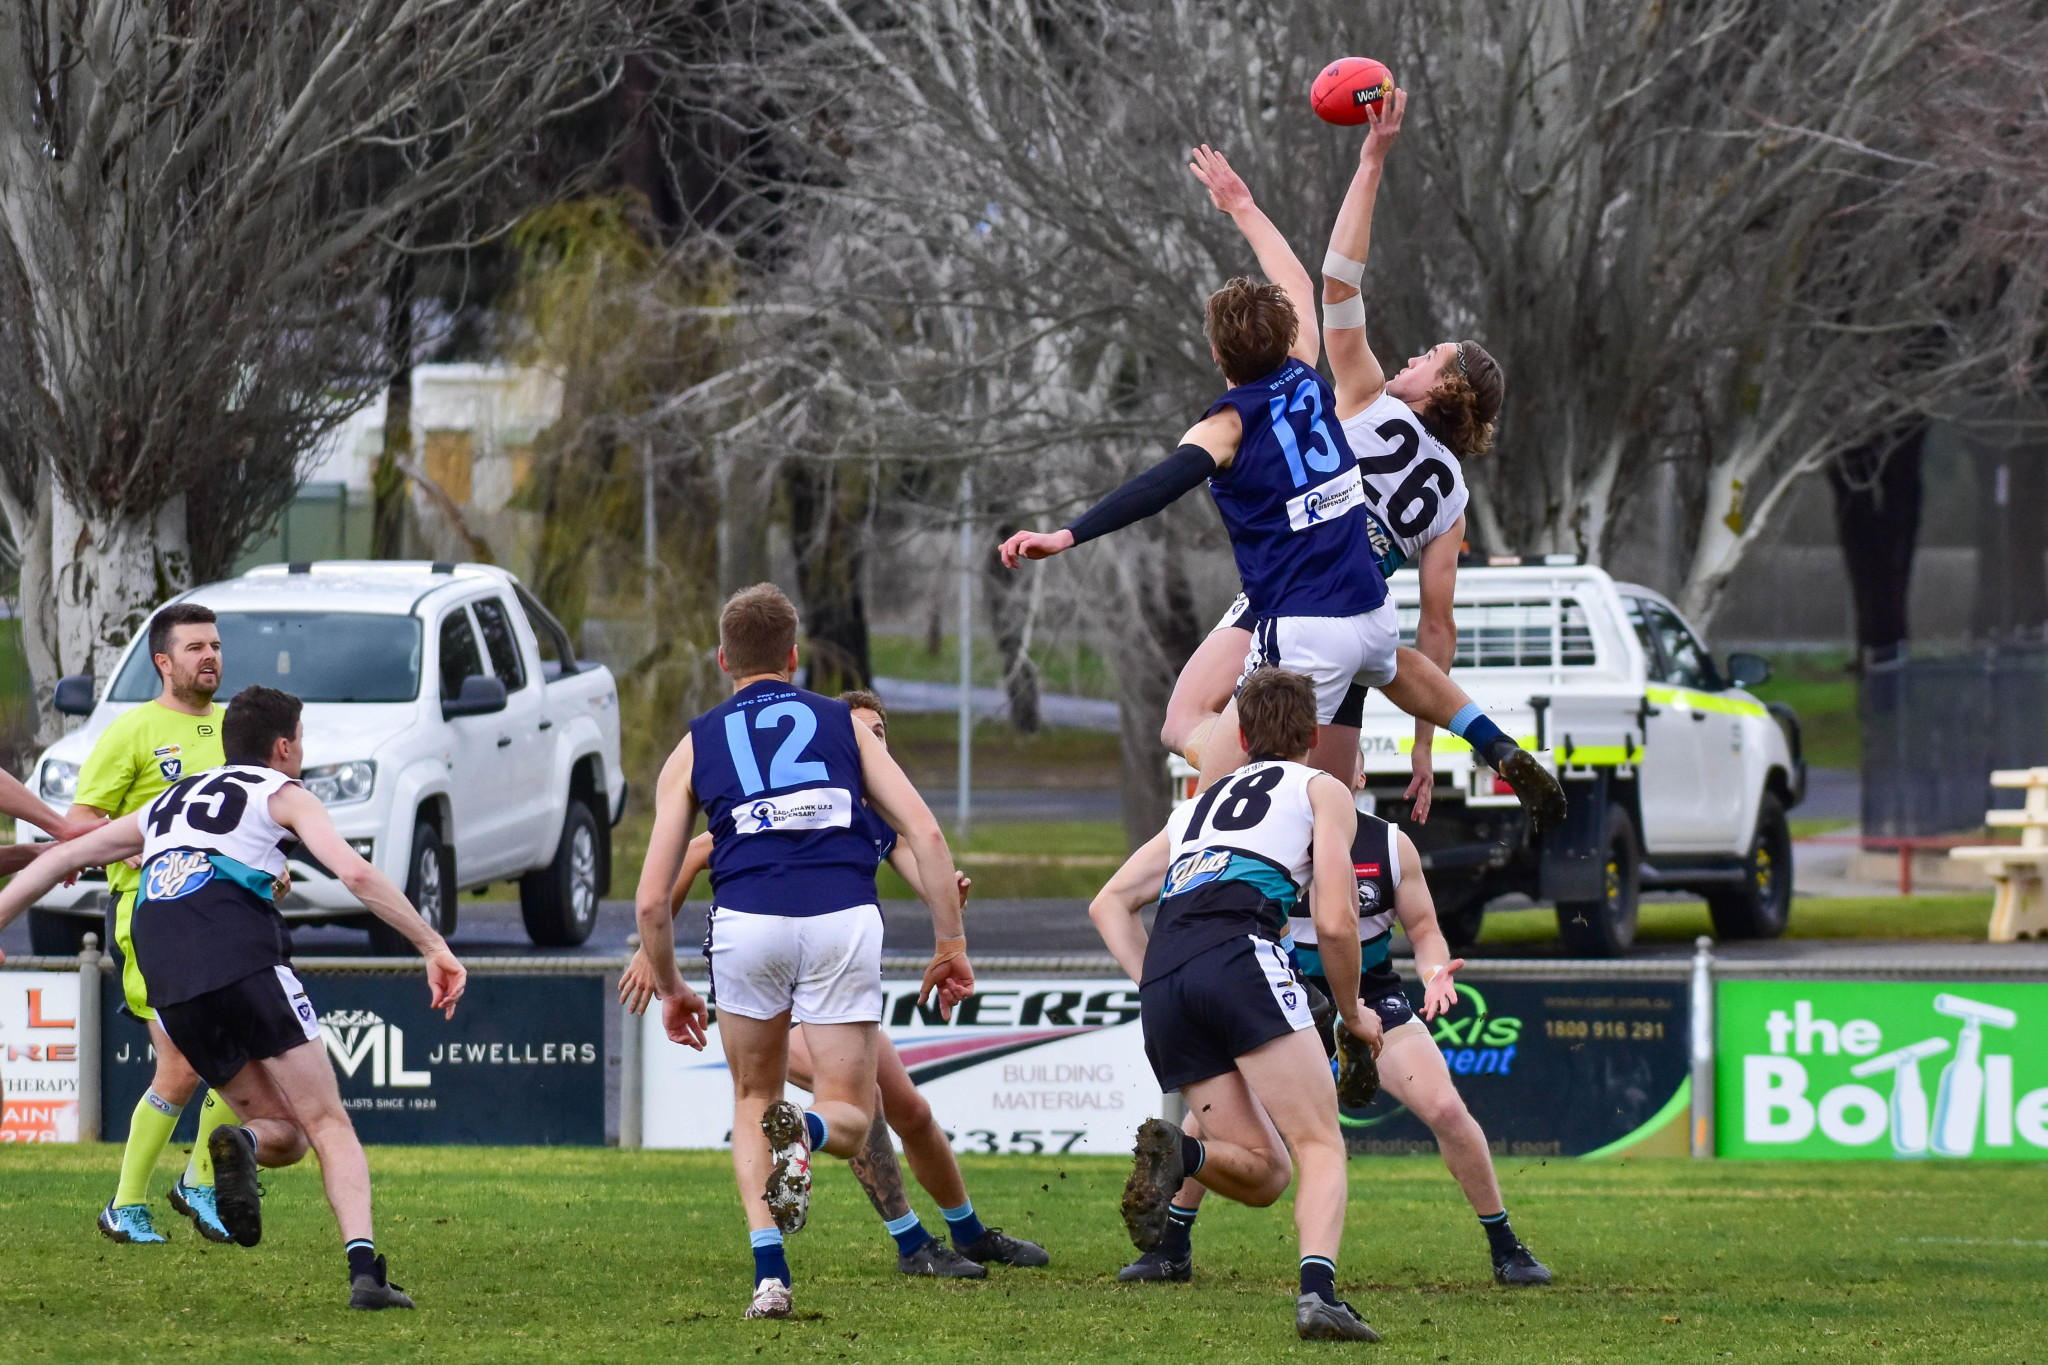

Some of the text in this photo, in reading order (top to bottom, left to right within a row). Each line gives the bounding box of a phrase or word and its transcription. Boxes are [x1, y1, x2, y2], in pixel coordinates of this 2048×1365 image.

[1269, 378, 1341, 488] 13
[1357, 418, 1455, 538] 26
[724, 701, 830, 797] 12
[1360, 737, 1396, 752] OTA
[147, 771, 266, 837] 45
[1182, 766, 1285, 844] 18
[26, 988, 76, 1028] L
[883, 991, 1141, 1026] NERS
[1433, 1016, 1523, 1046] xis
[1545, 1021, 1665, 1039] 1800 916 291
[1764, 1000, 1883, 1055] the
[429, 1043, 597, 1064] JEWELLERS
[1003, 1064, 1115, 1083] BUILDING
[342, 1098, 437, 1109] ALISTS SINCE 1928
[992, 1091, 1125, 1110] MATERIALS
[0, 1129, 57, 1142] 278
[944, 1129, 1088, 1152] 357
